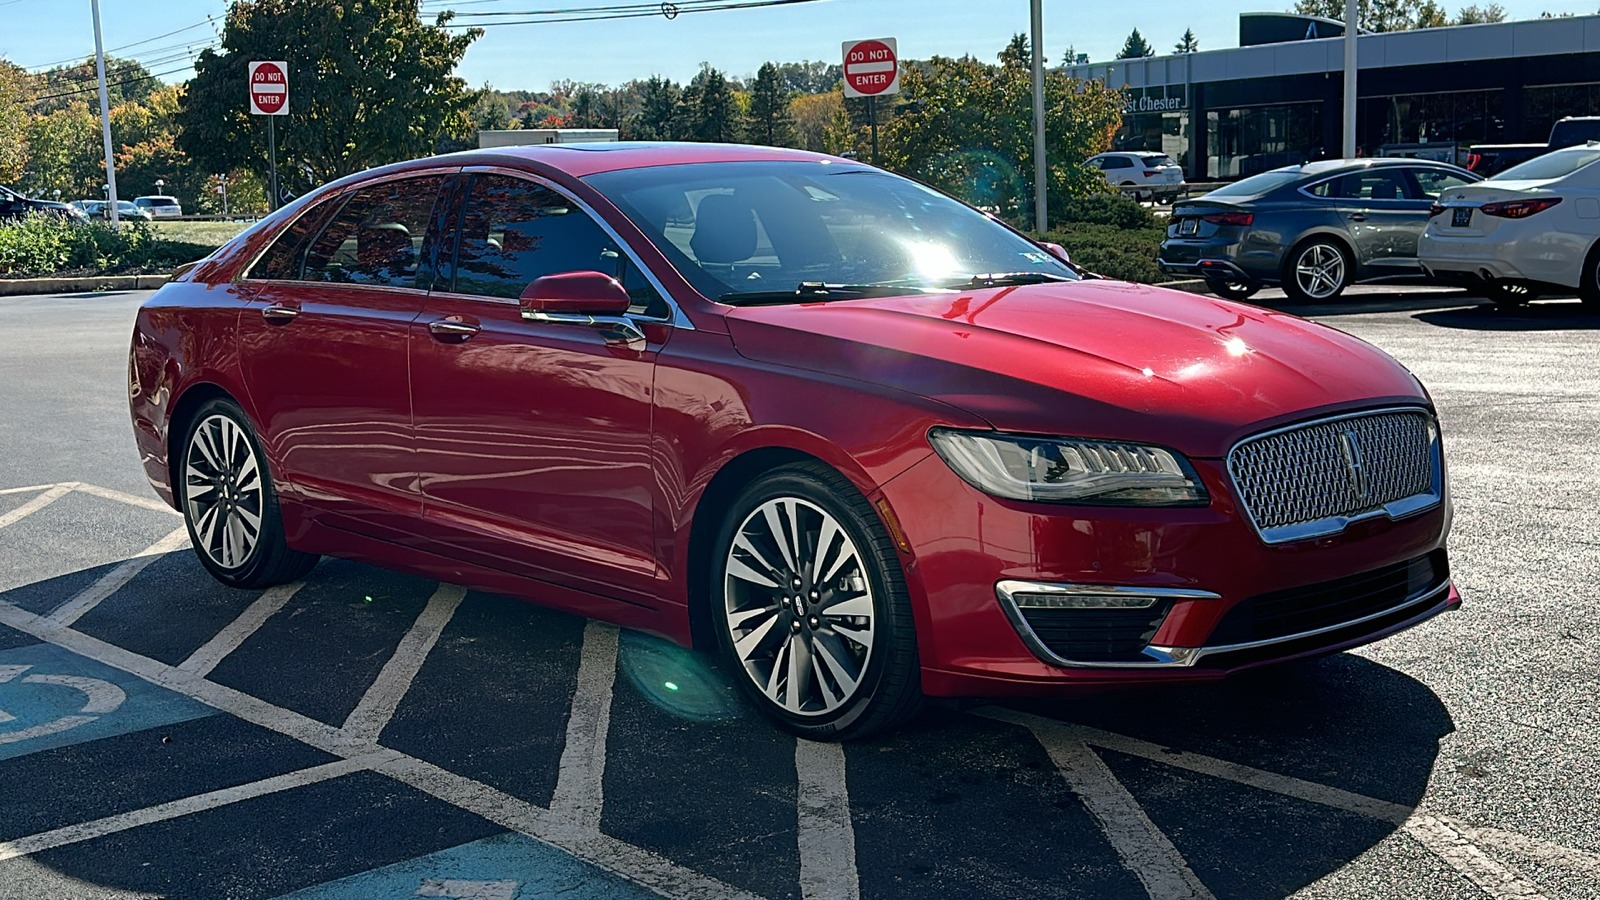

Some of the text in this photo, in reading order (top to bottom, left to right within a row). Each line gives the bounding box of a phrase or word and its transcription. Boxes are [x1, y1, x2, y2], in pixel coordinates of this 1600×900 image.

[851, 50, 888, 61] DO NOT
[255, 72, 281, 81] DO NOT
[856, 74, 887, 85] ENTER
[258, 96, 280, 104] ENTER
[1139, 96, 1181, 112] Chester
